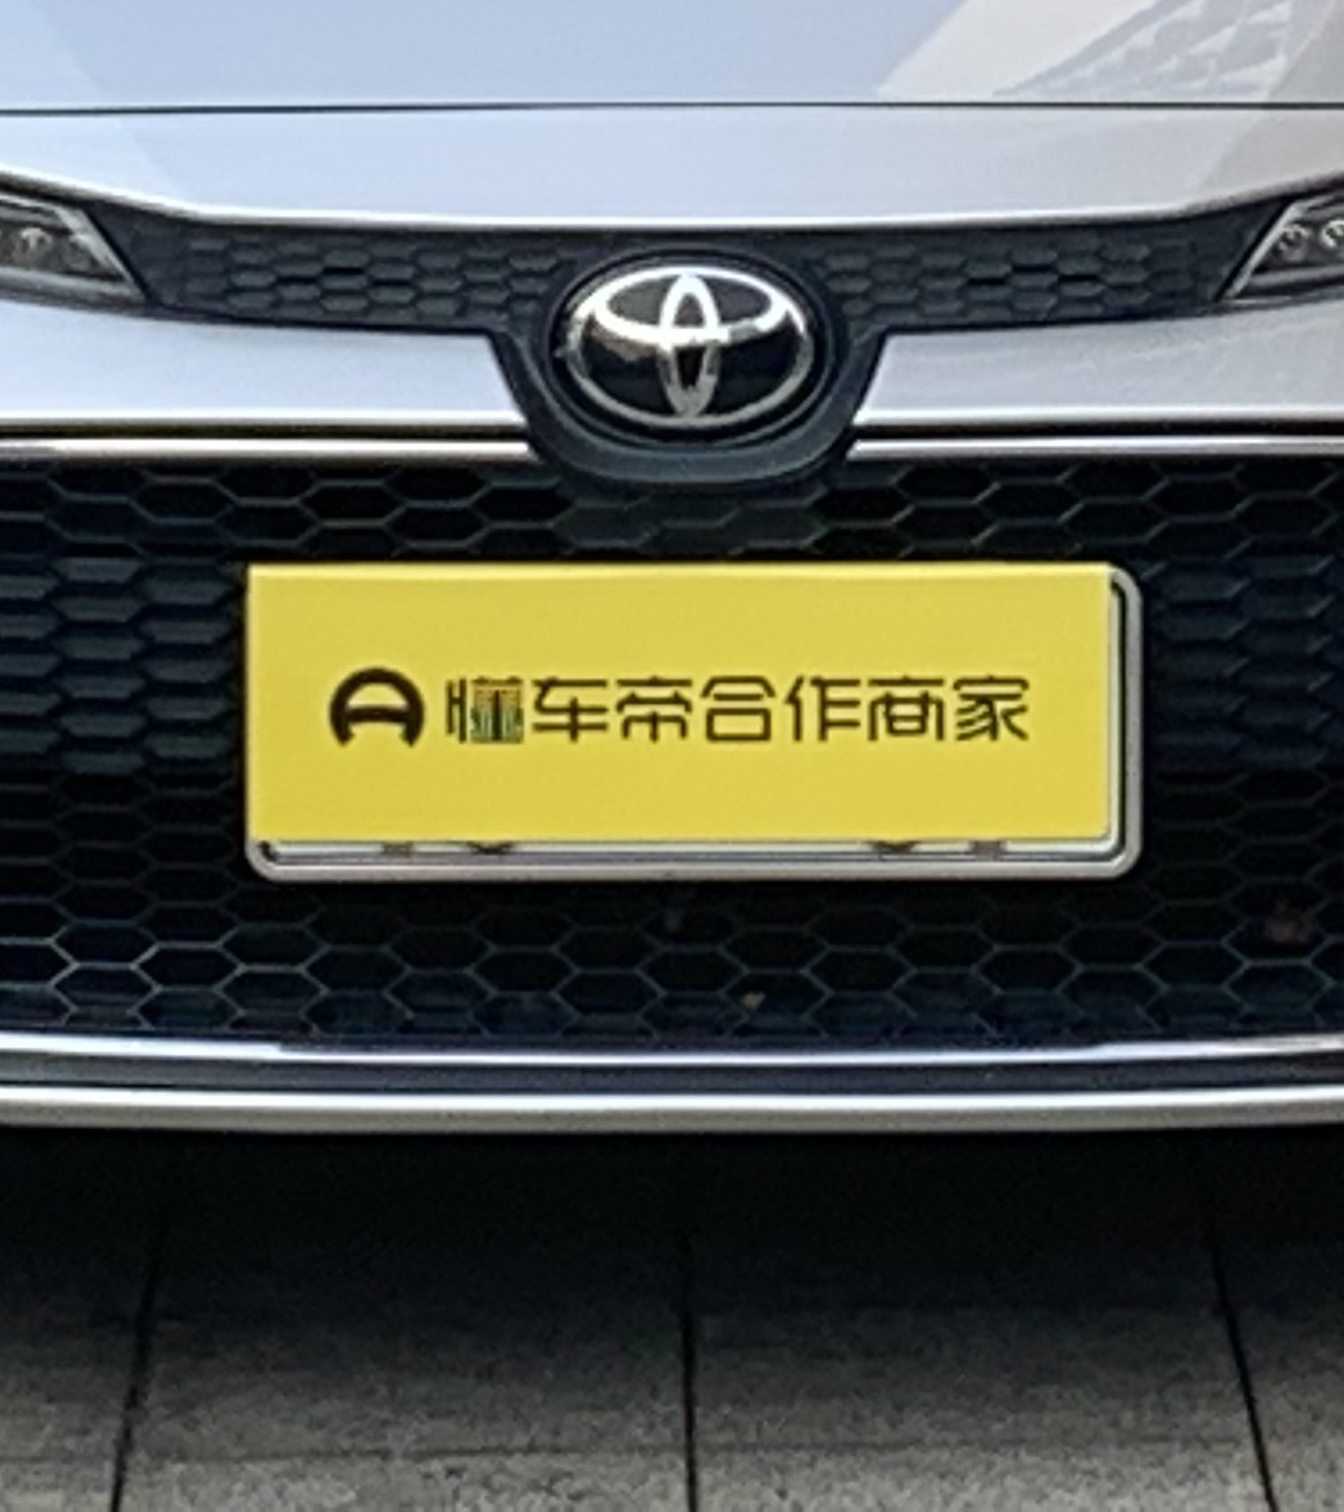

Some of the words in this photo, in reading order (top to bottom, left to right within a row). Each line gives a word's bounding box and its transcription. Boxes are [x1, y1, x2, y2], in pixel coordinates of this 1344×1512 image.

[445, 674, 1030, 744] 懂车帝合作商家
